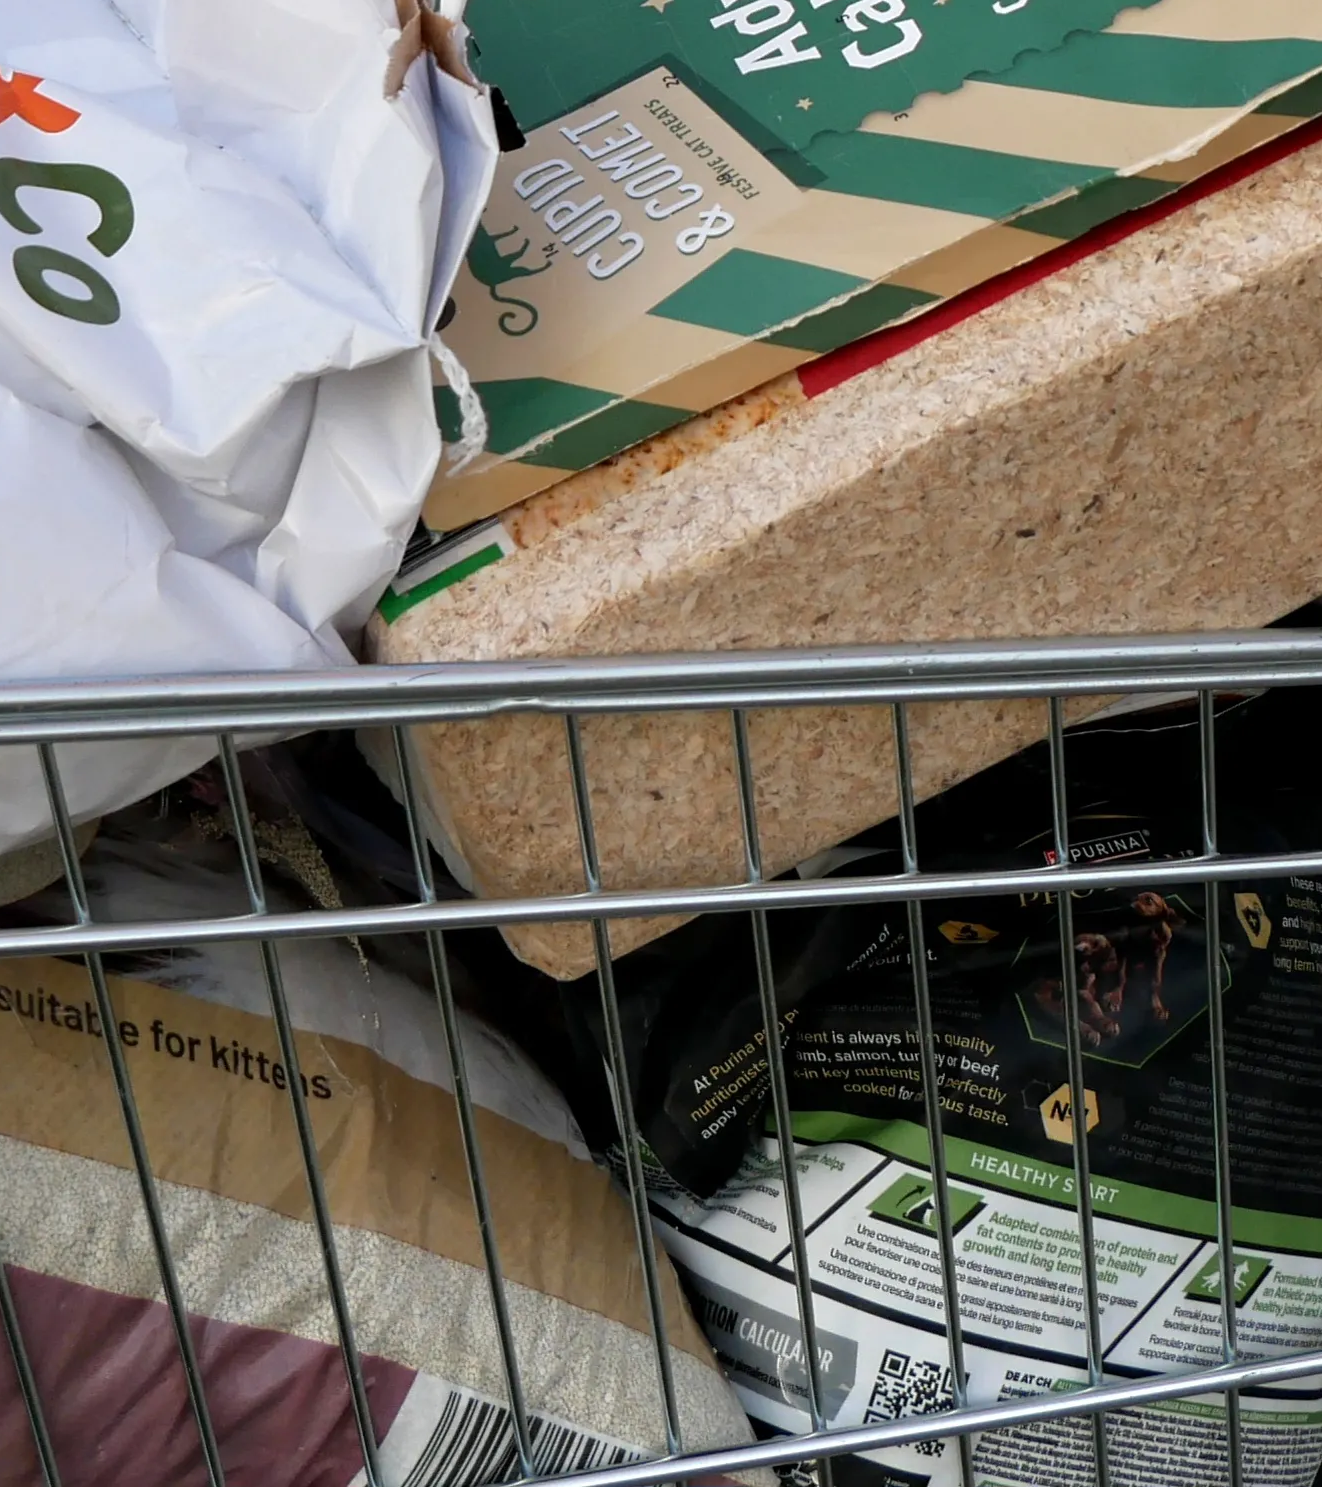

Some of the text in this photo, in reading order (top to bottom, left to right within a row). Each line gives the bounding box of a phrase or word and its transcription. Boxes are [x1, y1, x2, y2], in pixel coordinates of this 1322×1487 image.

[643, 98, 714, 158] CAT TREATS
[558, 109, 736, 255] & COMET
[513, 158, 645, 280] CUPID
[1070, 834, 1142, 863] PURINA
[878, 923, 890, 943] of
[1282, 914, 1300, 929] and
[1279, 936, 1309, 954] support
[1274, 954, 1315, 973] long term
[151, 1019, 202, 1062] for
[831, 1030, 996, 1057] is always quality
[692, 1042, 757, 1094] At Purina
[835, 1051, 1001, 1082] salmon, or beef,
[689, 1058, 769, 1122] nutritionists
[822, 1067, 1008, 1105] key nutrients perfectly
[842, 1081, 1010, 1127] cooked for taste.
[700, 1105, 738, 1140] apply
[970, 1151, 1060, 1194] HEALTHY
[857, 1224, 931, 1255] Une combinaison
[977, 1225, 1148, 1278] fat contents to healthy
[989, 1210, 1179, 1265] Adapted of protein and
[818, 1258, 862, 1283] supportare
[845, 1254, 908, 1283] combinazione
[962, 1239, 1081, 1276] growth and long term
[1005, 1369, 1052, 1390] DE AT CH
